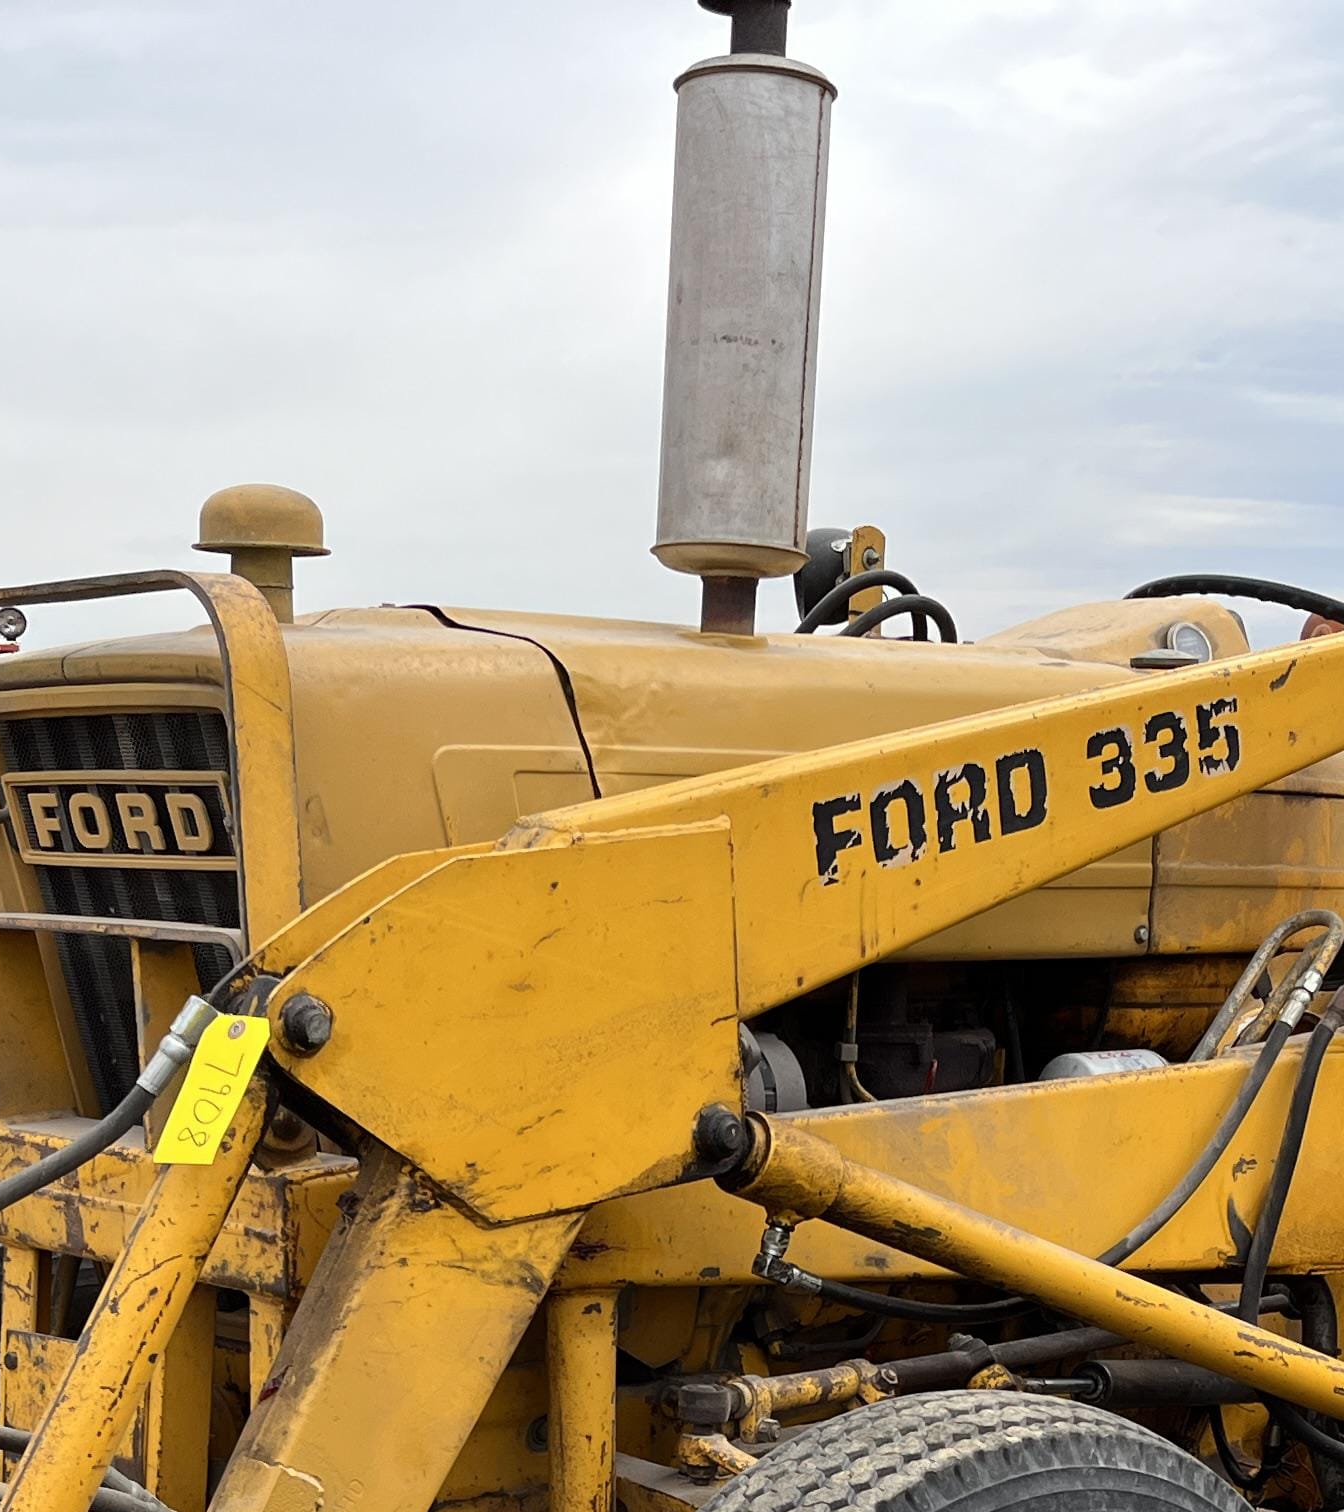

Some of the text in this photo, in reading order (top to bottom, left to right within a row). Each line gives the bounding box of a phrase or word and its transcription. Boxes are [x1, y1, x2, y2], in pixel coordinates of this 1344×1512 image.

[26, 791, 215, 852] FORD
[812, 696, 1241, 887] FORD 335
[177, 1053, 245, 1147] 7908
